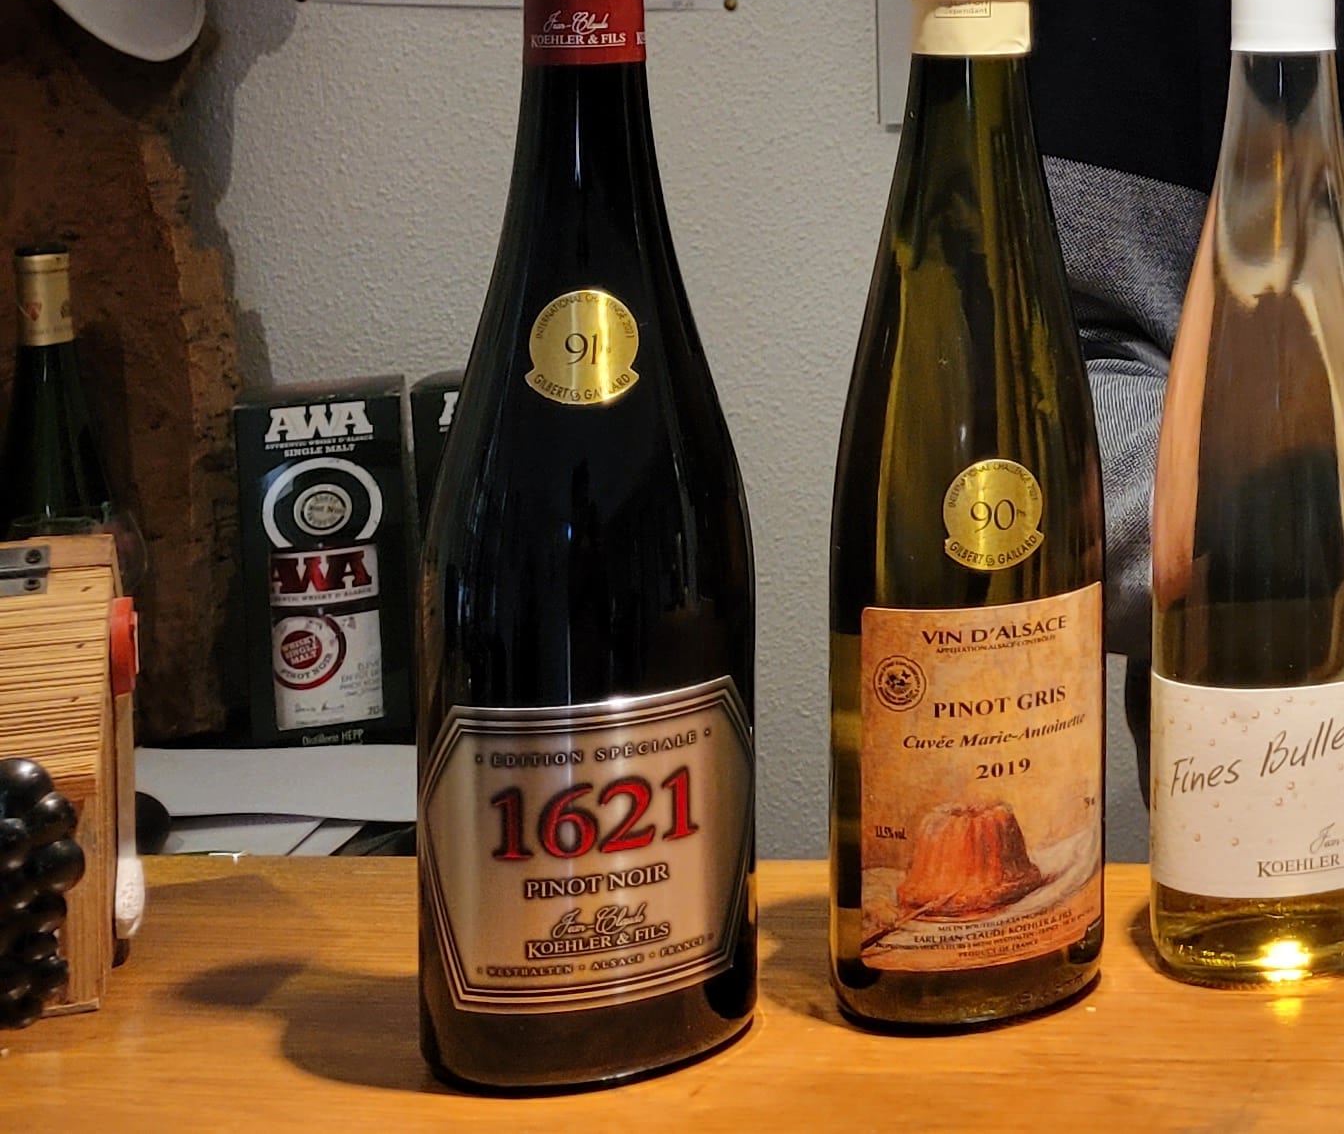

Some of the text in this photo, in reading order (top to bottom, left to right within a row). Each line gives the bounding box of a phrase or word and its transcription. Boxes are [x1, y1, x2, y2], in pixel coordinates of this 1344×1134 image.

[531, 34, 584, 48] KOEHLER
[588, 35, 599, 45] &
[601, 32, 626, 45] FILS
[536, 295, 581, 339] INTERNATIONAL
[565, 333, 598, 365] 91
[534, 374, 570, 398] GILBERT
[265, 401, 374, 443] AWA
[284, 444, 355, 457] SINGLE MALT
[970, 499, 1015, 533] 90
[950, 535, 1037, 564] GILBERT GAILLARD
[271, 551, 372, 595] AWA
[921, 615, 1068, 645] VIN D'ALSACE
[281, 653, 333, 680] PINOT NOIR
[933, 684, 1067, 719] PINOT GRIS
[342, 729, 364, 741] HEPP
[596, 731, 697, 761] SPÉCIALE
[902, 713, 1086, 749] Cuvée Marie-Antoinette
[976, 757, 1032, 780] 2019
[1170, 757, 1243, 797] Fines
[490, 765, 700, 863] 1621
[524, 864, 669, 900] PINOT NOIR
[1257, 853, 1340, 878] KOEHLER
[486, 938, 704, 977] WESTHALTEN ALSACE FRANCE
[527, 923, 669, 960] KOEHLER & FILS
